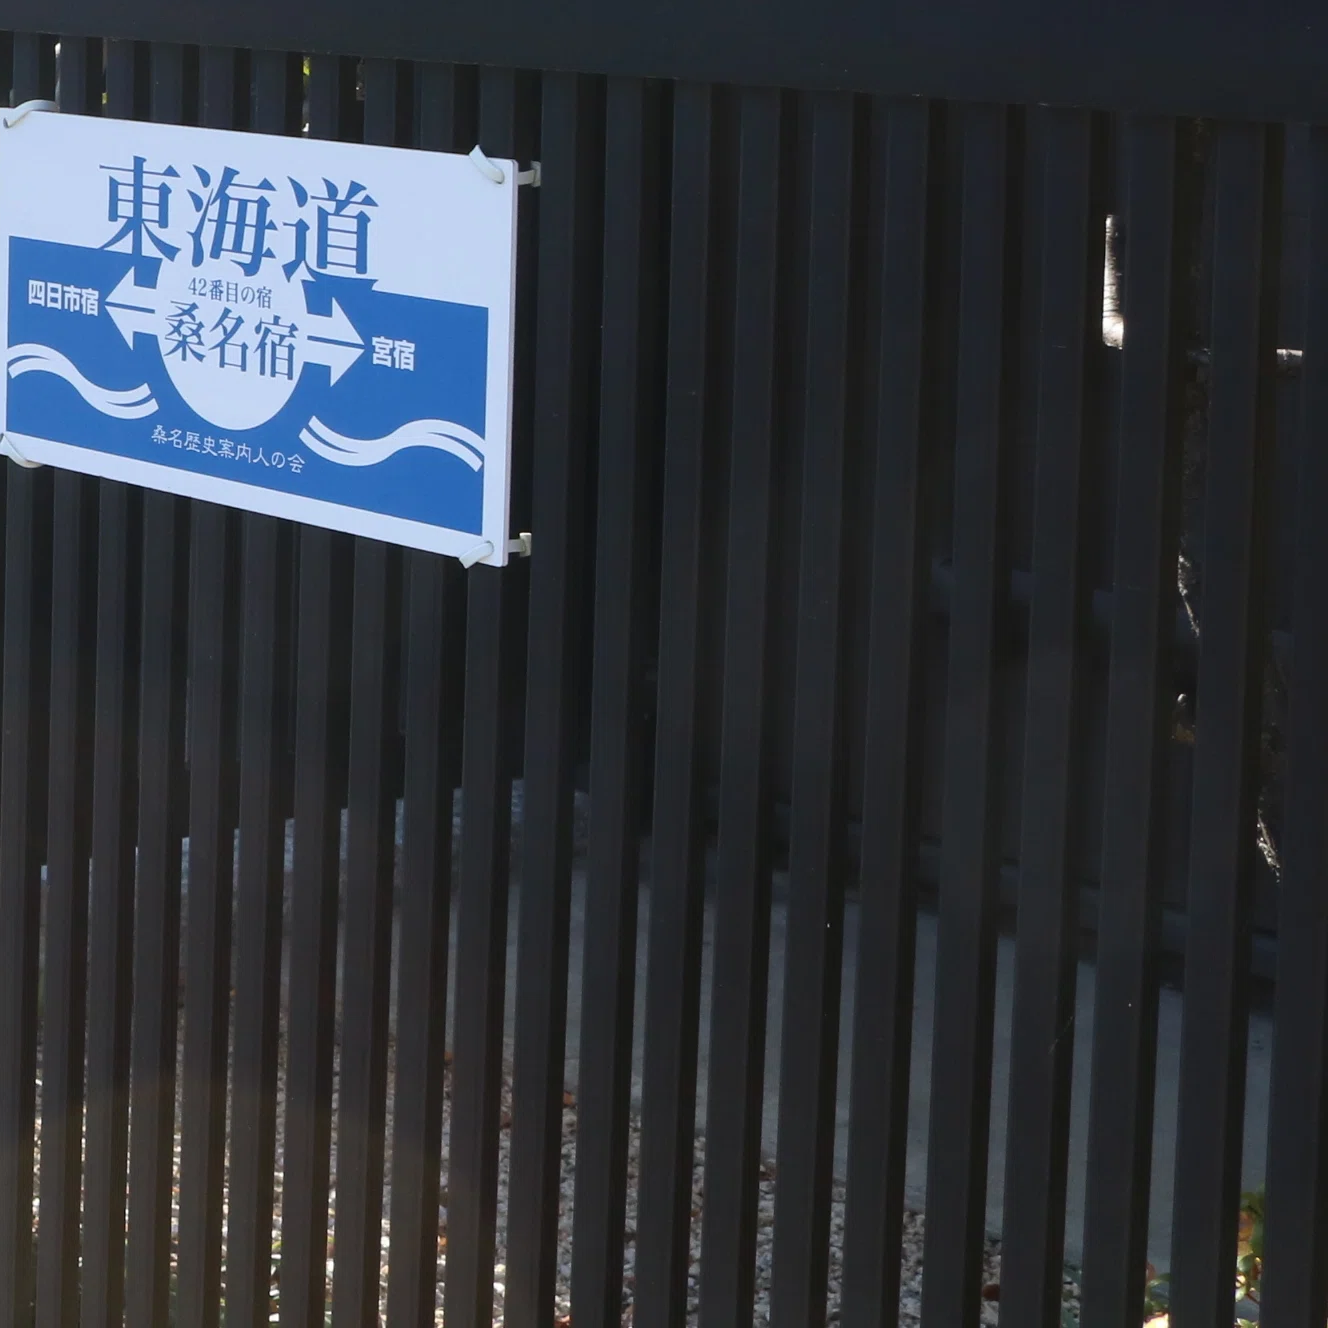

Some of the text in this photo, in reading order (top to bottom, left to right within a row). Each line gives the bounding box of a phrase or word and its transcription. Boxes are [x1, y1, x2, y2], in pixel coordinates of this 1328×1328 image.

[98, 156, 379, 283] 東海道
[28, 279, 99, 317] 四日市宿
[187, 276, 273, 309] 42番目の宿
[163, 300, 299, 380] 桑名宿
[371, 335, 416, 372] 宮宿
[151, 424, 306, 474] 桑名歴史案内人の会
